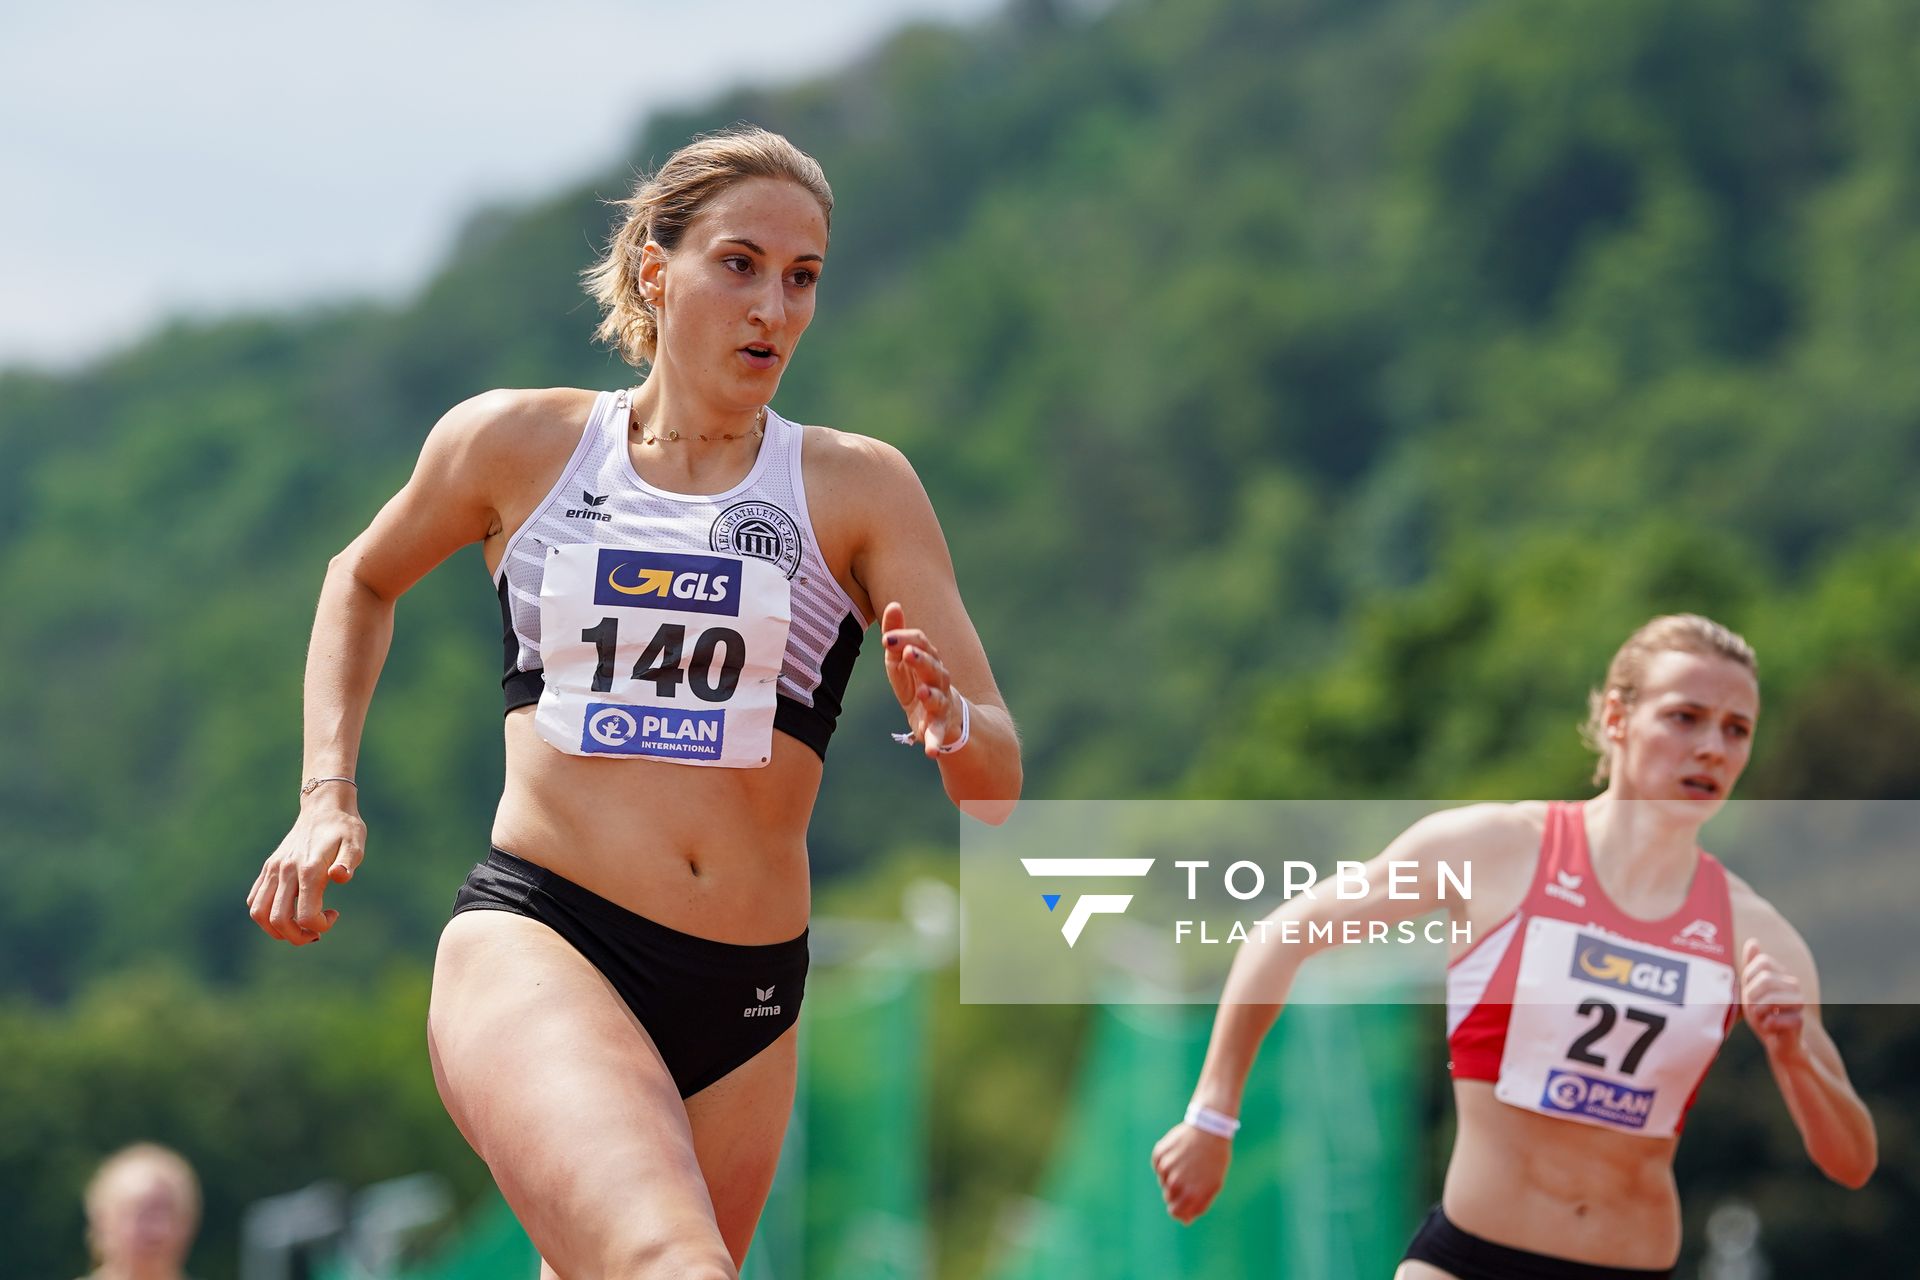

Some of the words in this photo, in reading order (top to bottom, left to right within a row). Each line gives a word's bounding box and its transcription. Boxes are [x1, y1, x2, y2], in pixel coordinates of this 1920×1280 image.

[566, 508, 612, 522] erima
[719, 507, 795, 563] LEICHTATHLETIK-TEAM
[672, 572, 730, 602] GLS
[581, 616, 746, 703] 140
[642, 715, 719, 742] PLAN
[641, 741, 716, 754] INTERNATIONAL
[1629, 962, 1681, 997] GLS
[743, 1004, 781, 1018] erima
[1565, 997, 1668, 1076] 27
[1588, 1083, 1652, 1116] PLAN
